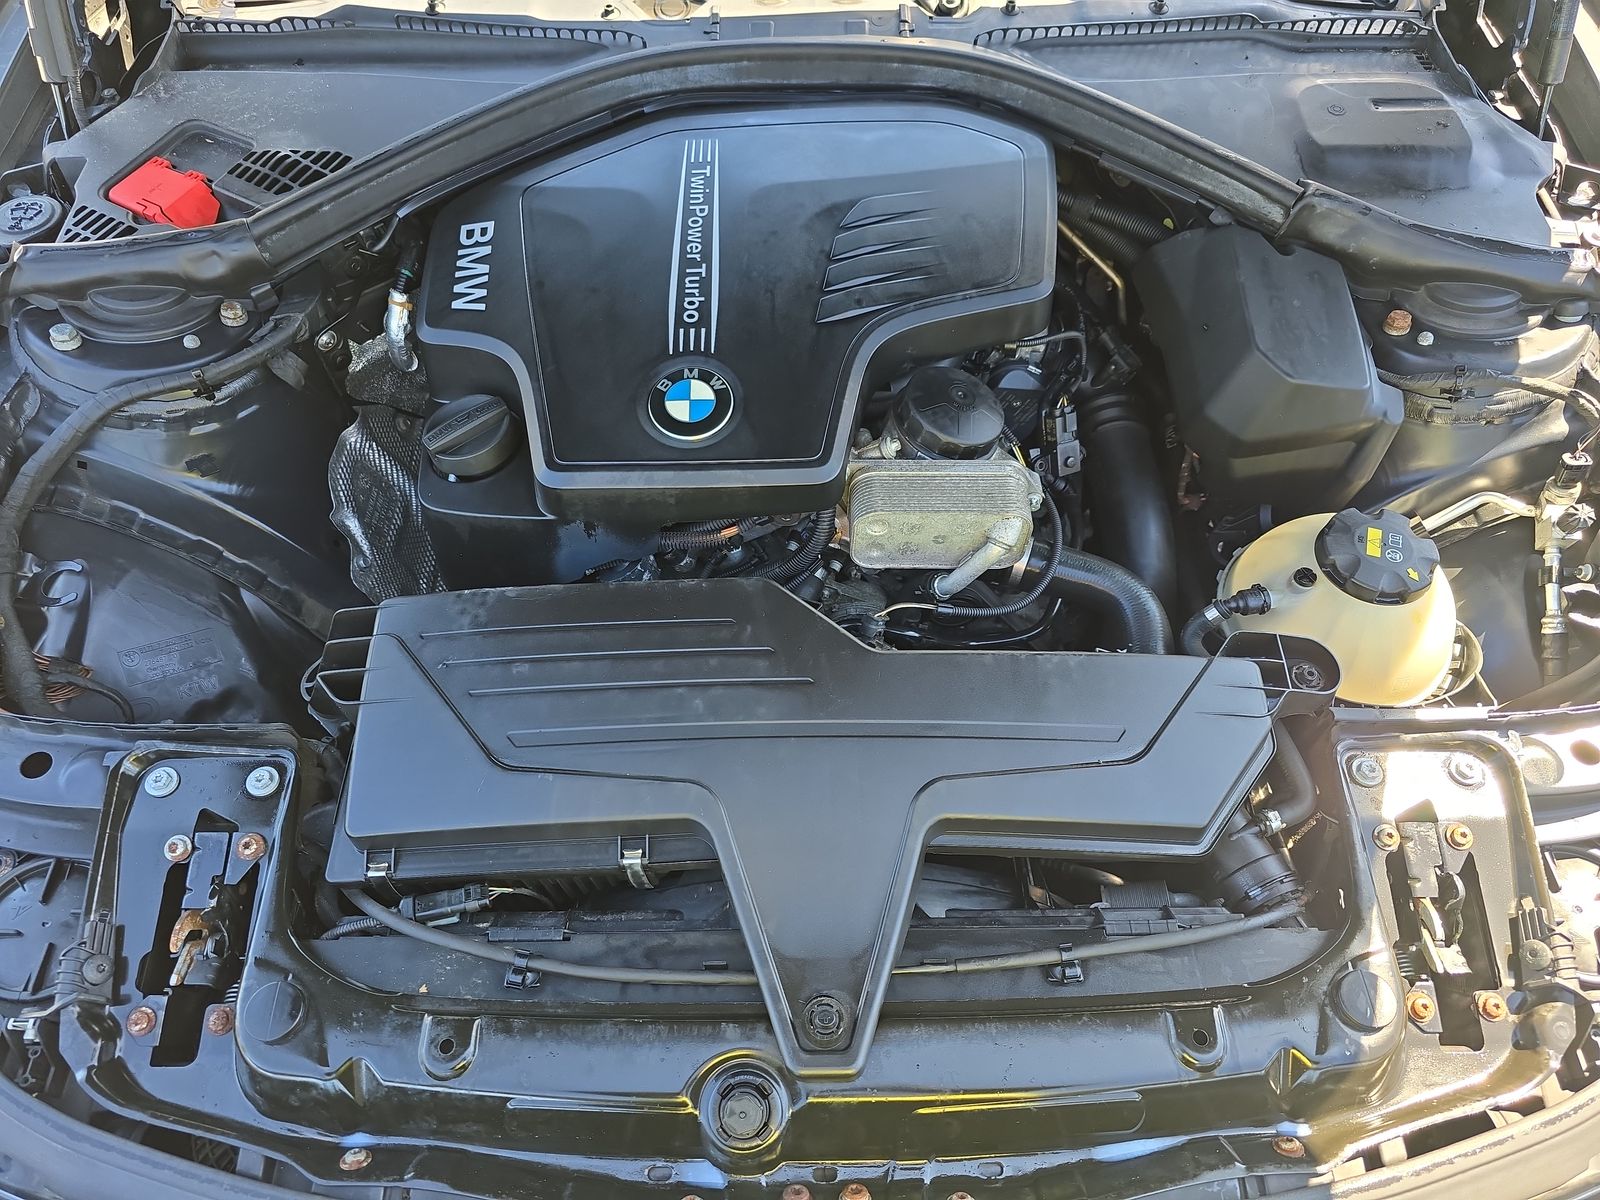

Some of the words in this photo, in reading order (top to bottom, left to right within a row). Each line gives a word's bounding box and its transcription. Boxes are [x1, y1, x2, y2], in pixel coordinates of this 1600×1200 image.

[451, 220, 495, 311] BMW
[683, 262, 707, 324] Turbo
[656, 367, 726, 393] BMW
